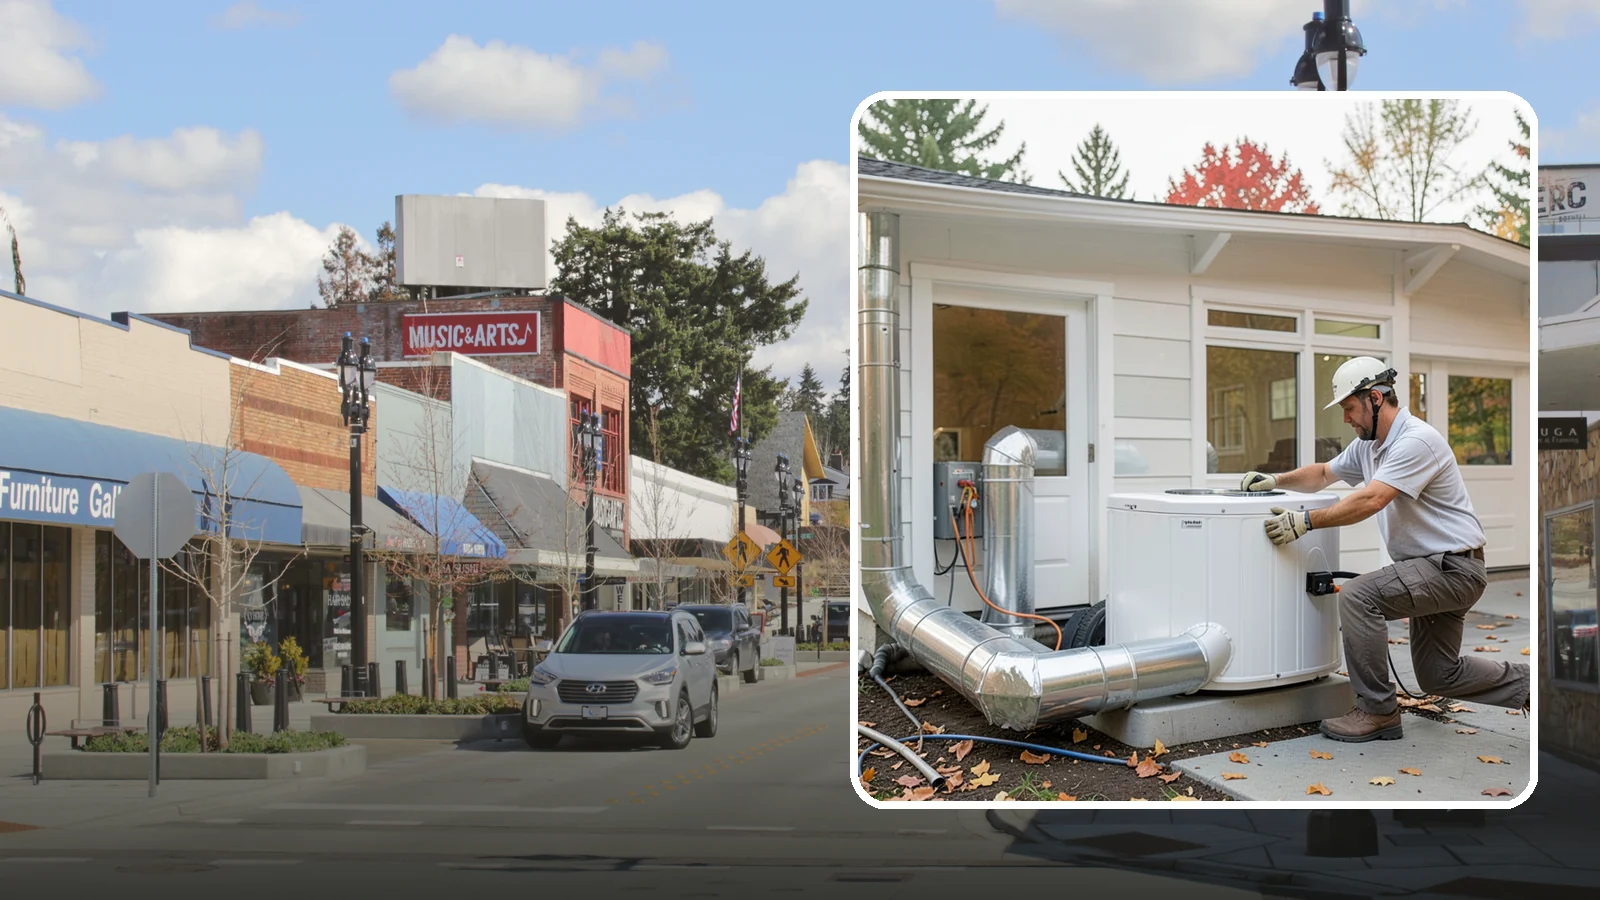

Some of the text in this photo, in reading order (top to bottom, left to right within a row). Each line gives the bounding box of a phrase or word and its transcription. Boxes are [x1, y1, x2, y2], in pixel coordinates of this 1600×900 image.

[1540, 427, 1577, 437] UGA
[0, 471, 121, 519] Furniture Gal
[454, 563, 479, 574] SUSHI
